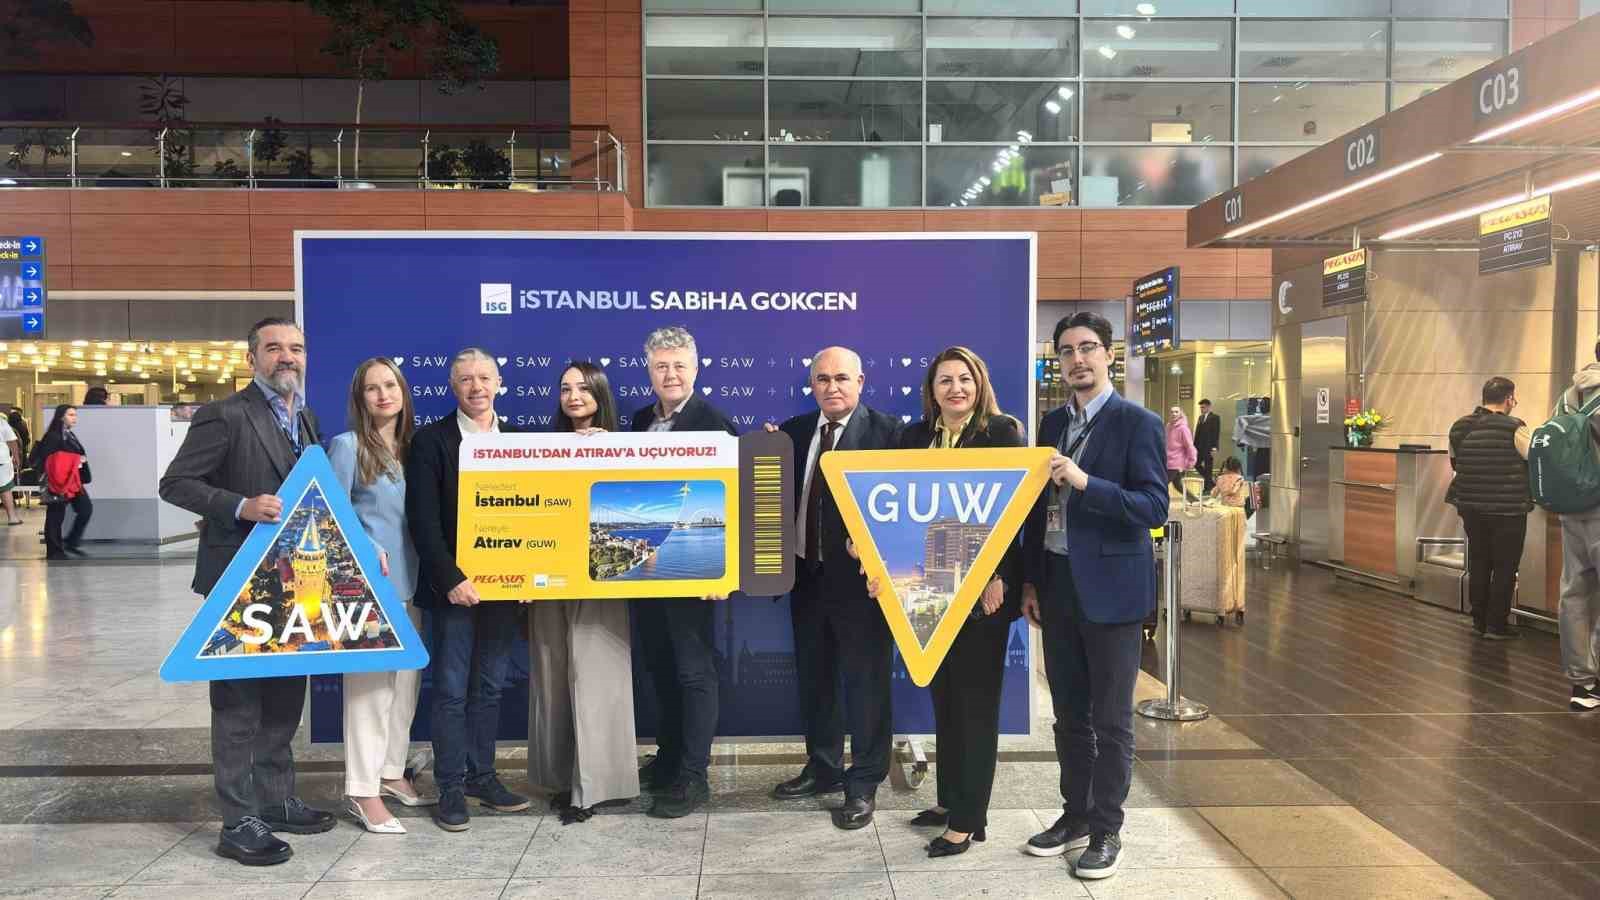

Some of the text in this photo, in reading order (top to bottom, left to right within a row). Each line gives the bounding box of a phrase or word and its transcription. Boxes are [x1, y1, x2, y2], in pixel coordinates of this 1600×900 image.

[1480, 67, 1519, 113] C03
[1348, 134, 1374, 170] C02
[1225, 195, 1241, 223] C01
[1279, 281, 1293, 314] C
[486, 302, 507, 312] ISG
[412, 357, 447, 367] SAW
[516, 357, 551, 367] SAW
[720, 357, 754, 368] SAW
[413, 386, 448, 396] SAW
[516, 386, 551, 396] SAW
[720, 387, 754, 397] SAW
[517, 415, 552, 426] SAW
[639, 446, 717, 459] UÇUYORUZ!
[475, 491, 572, 508] İstanbul (SAW)
[867, 482, 1002, 523] GUW
[474, 536, 556, 550] Atırav (GUW)
[472, 574, 526, 584] PEGASUS
[239, 602, 373, 645] SAW
